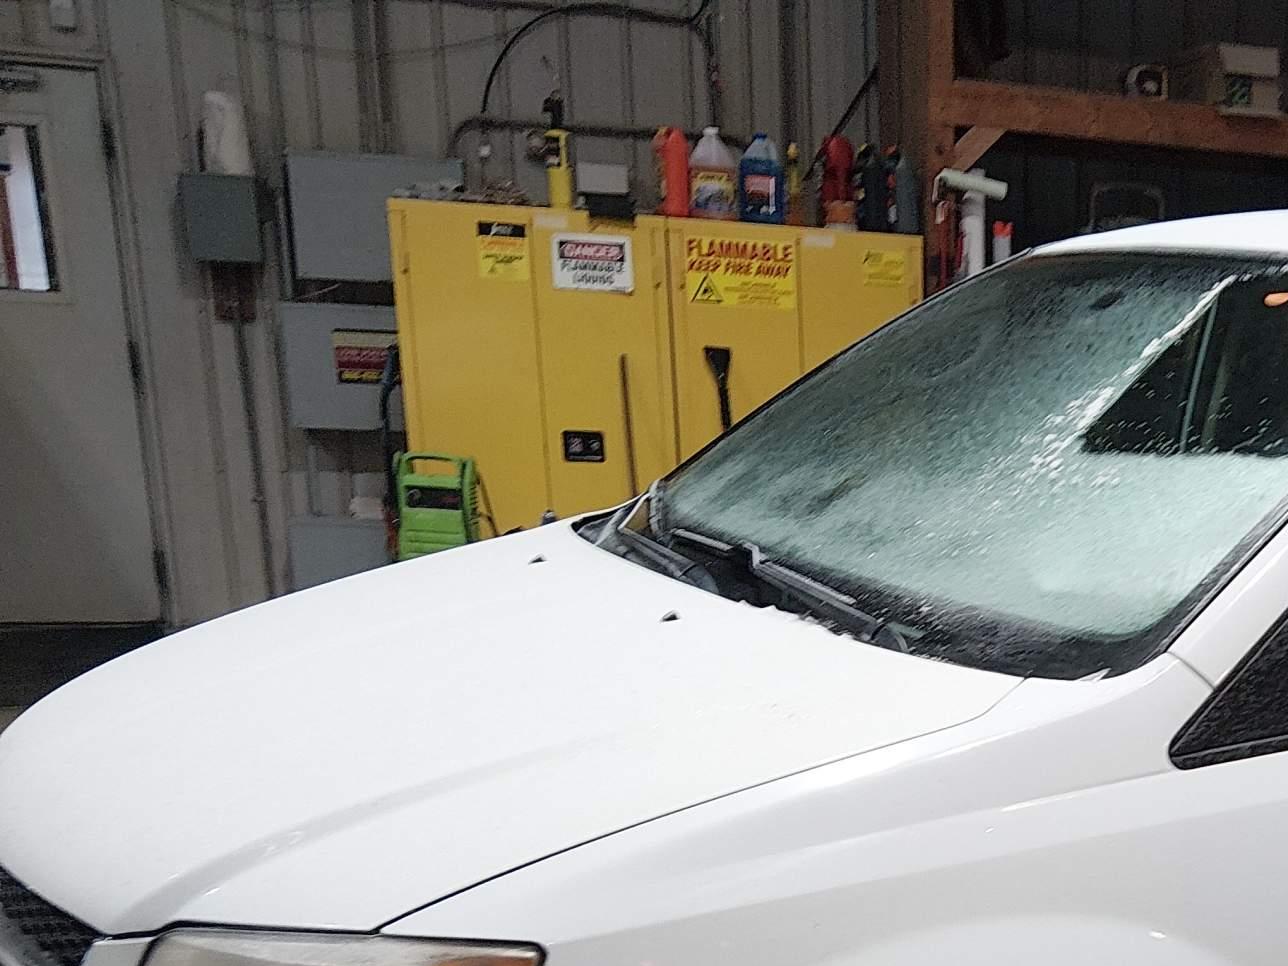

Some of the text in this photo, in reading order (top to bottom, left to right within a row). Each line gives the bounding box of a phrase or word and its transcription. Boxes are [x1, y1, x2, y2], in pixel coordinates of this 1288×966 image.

[688, 239, 792, 262] FLAMMABLE
[687, 258, 791, 278] KEEP FIRE AWAY
